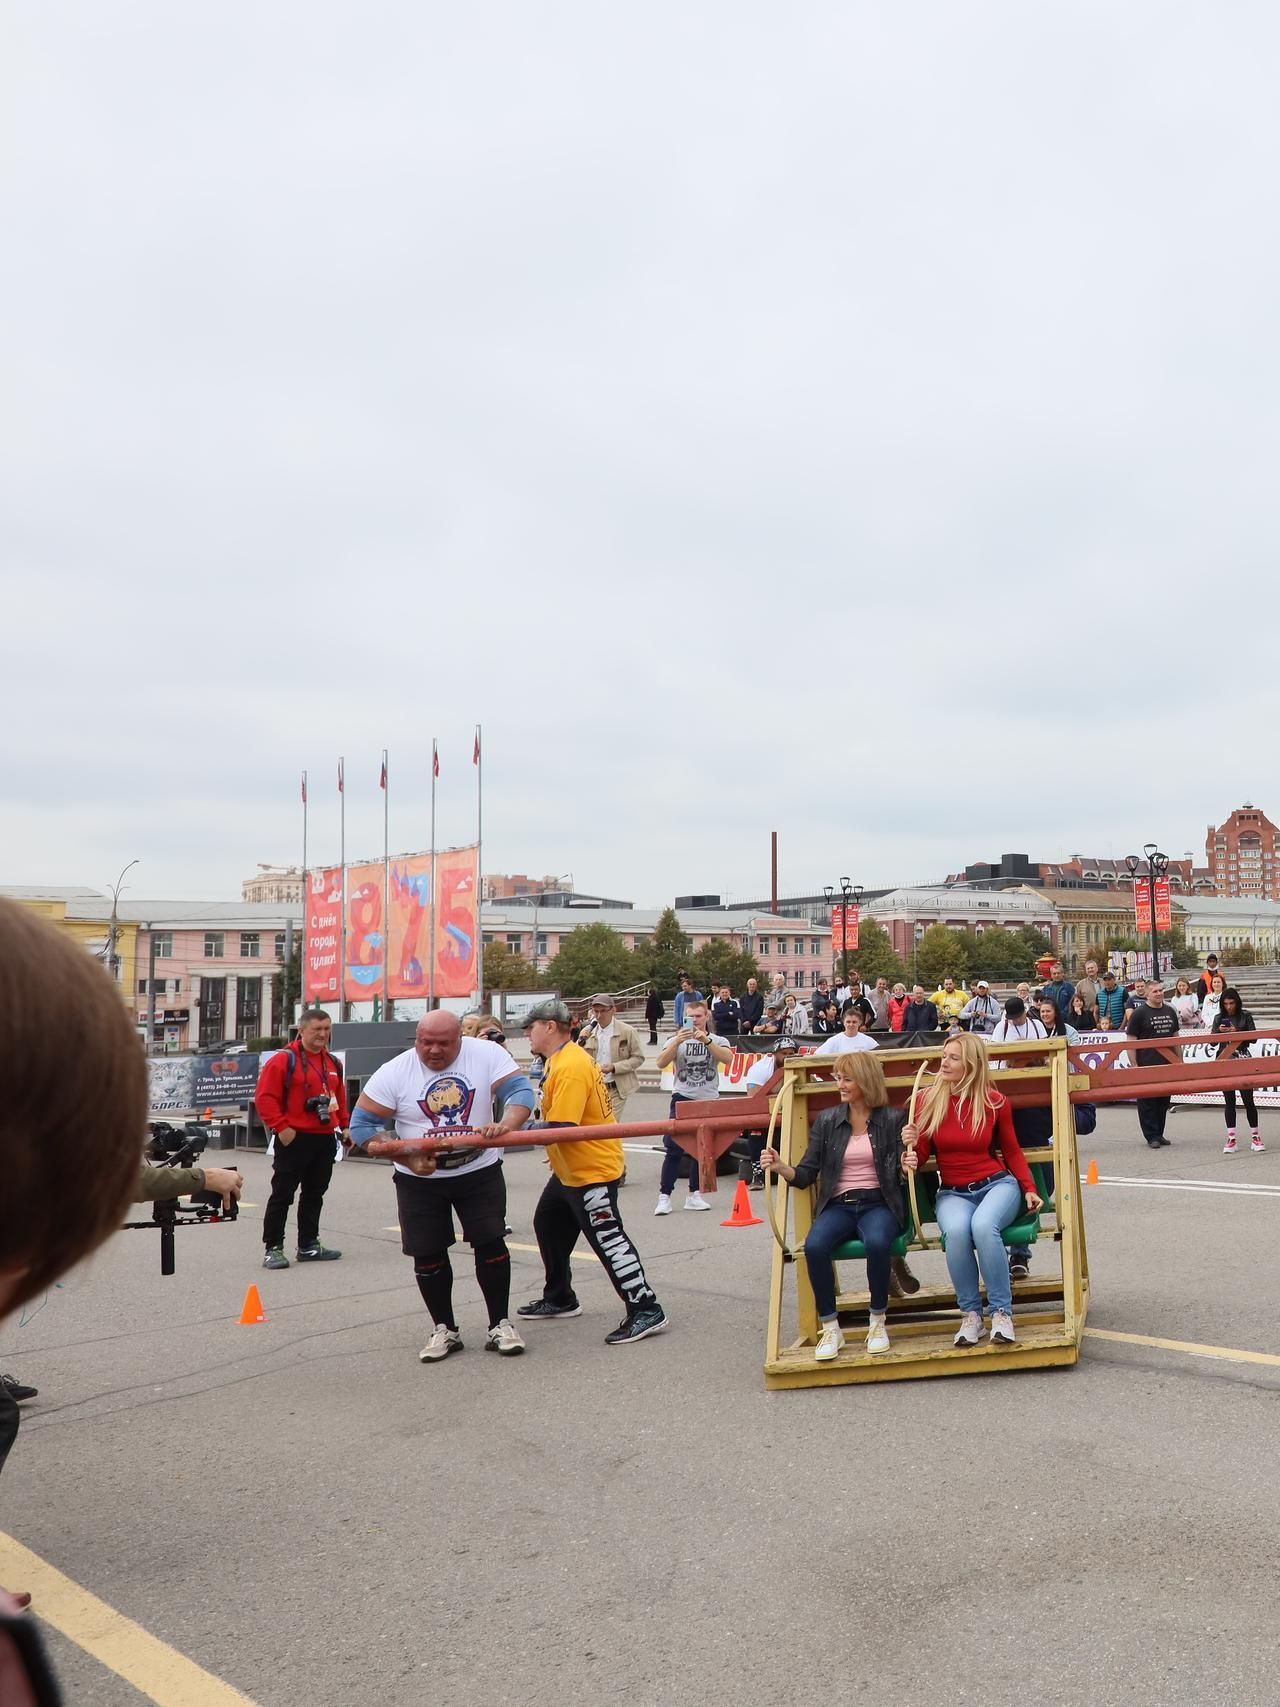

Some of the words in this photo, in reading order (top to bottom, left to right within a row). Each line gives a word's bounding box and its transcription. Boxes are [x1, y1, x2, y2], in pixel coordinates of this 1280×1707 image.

[311, 914, 318, 928] С
[1079, 1036, 1109, 1044] ЕНТР
[595, 1226, 654, 1304] LIMITS
